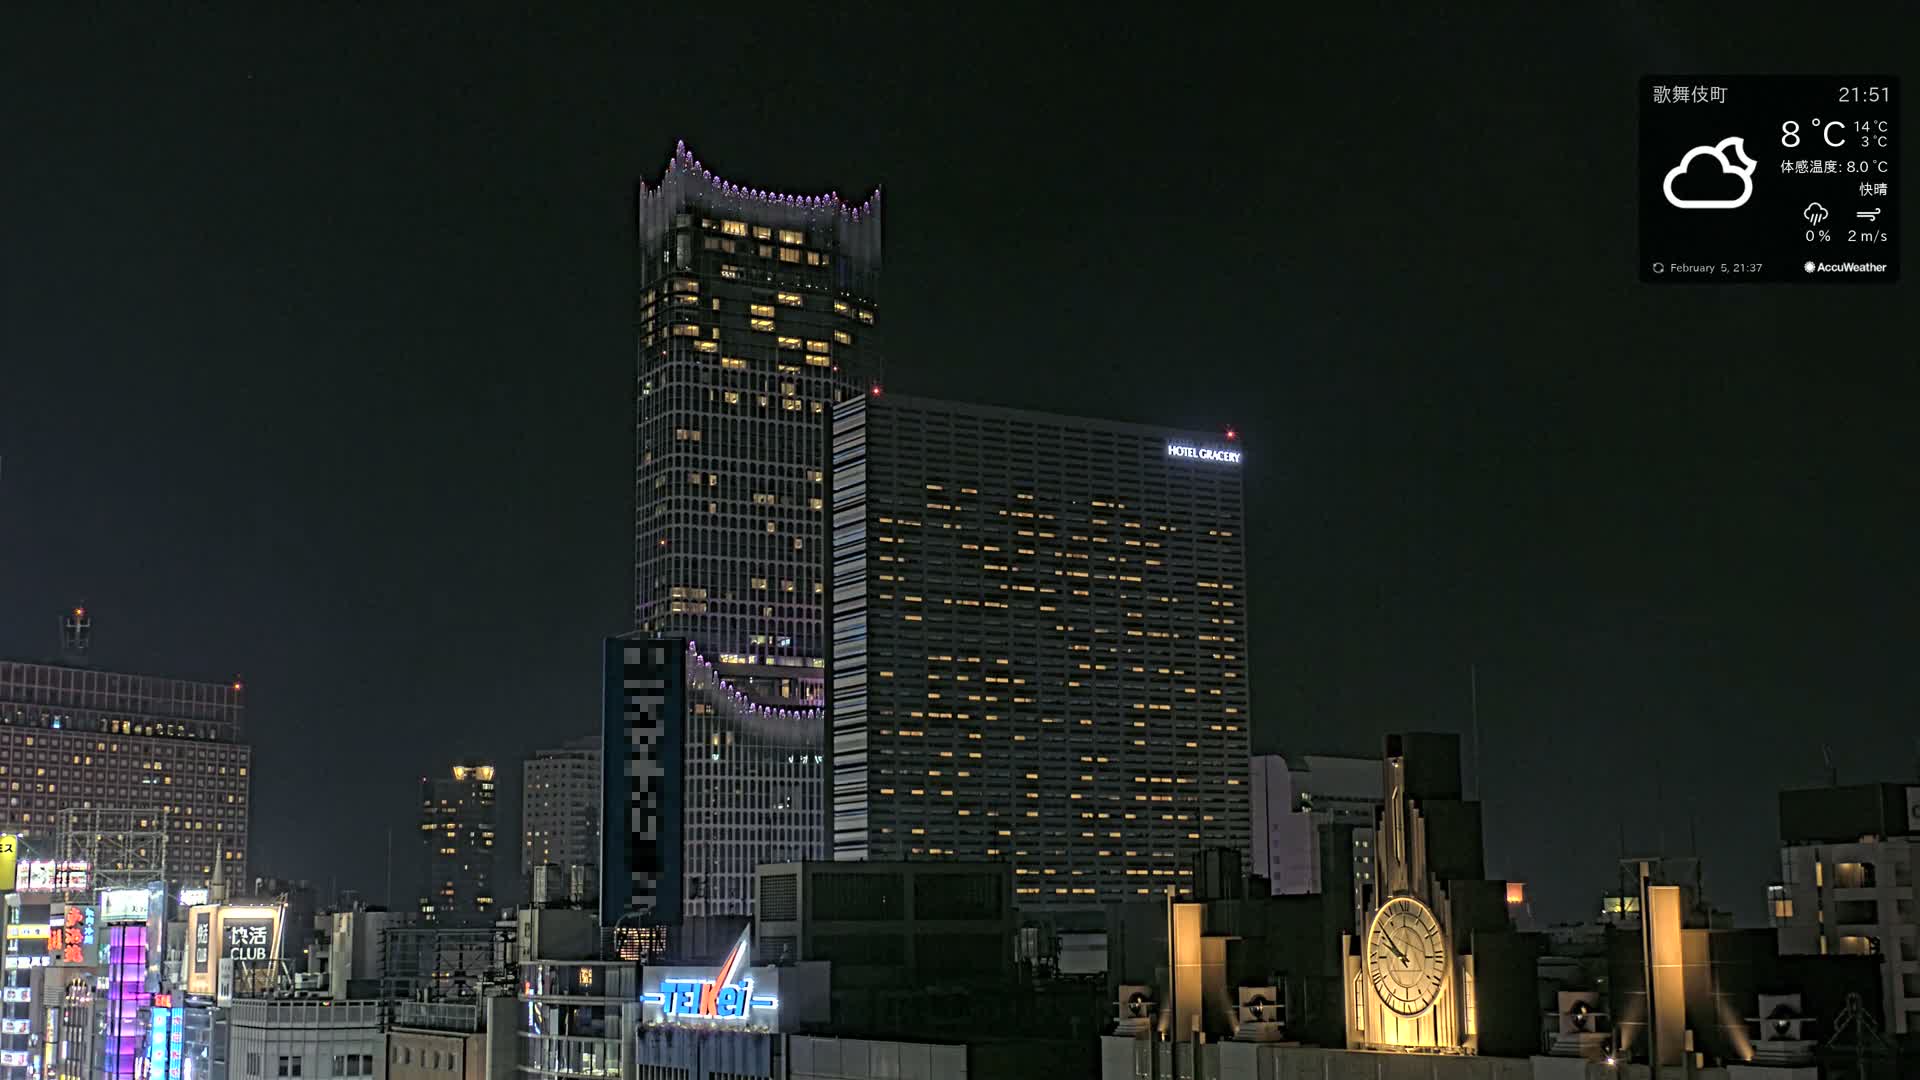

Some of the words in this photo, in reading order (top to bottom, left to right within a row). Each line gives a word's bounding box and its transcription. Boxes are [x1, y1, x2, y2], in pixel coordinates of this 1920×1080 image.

[1167, 445, 1198, 459] HOTEL
[1199, 448, 1241, 463] GRACERY
[231, 925, 268, 945] 快活
[230, 947, 266, 961] CLUB
